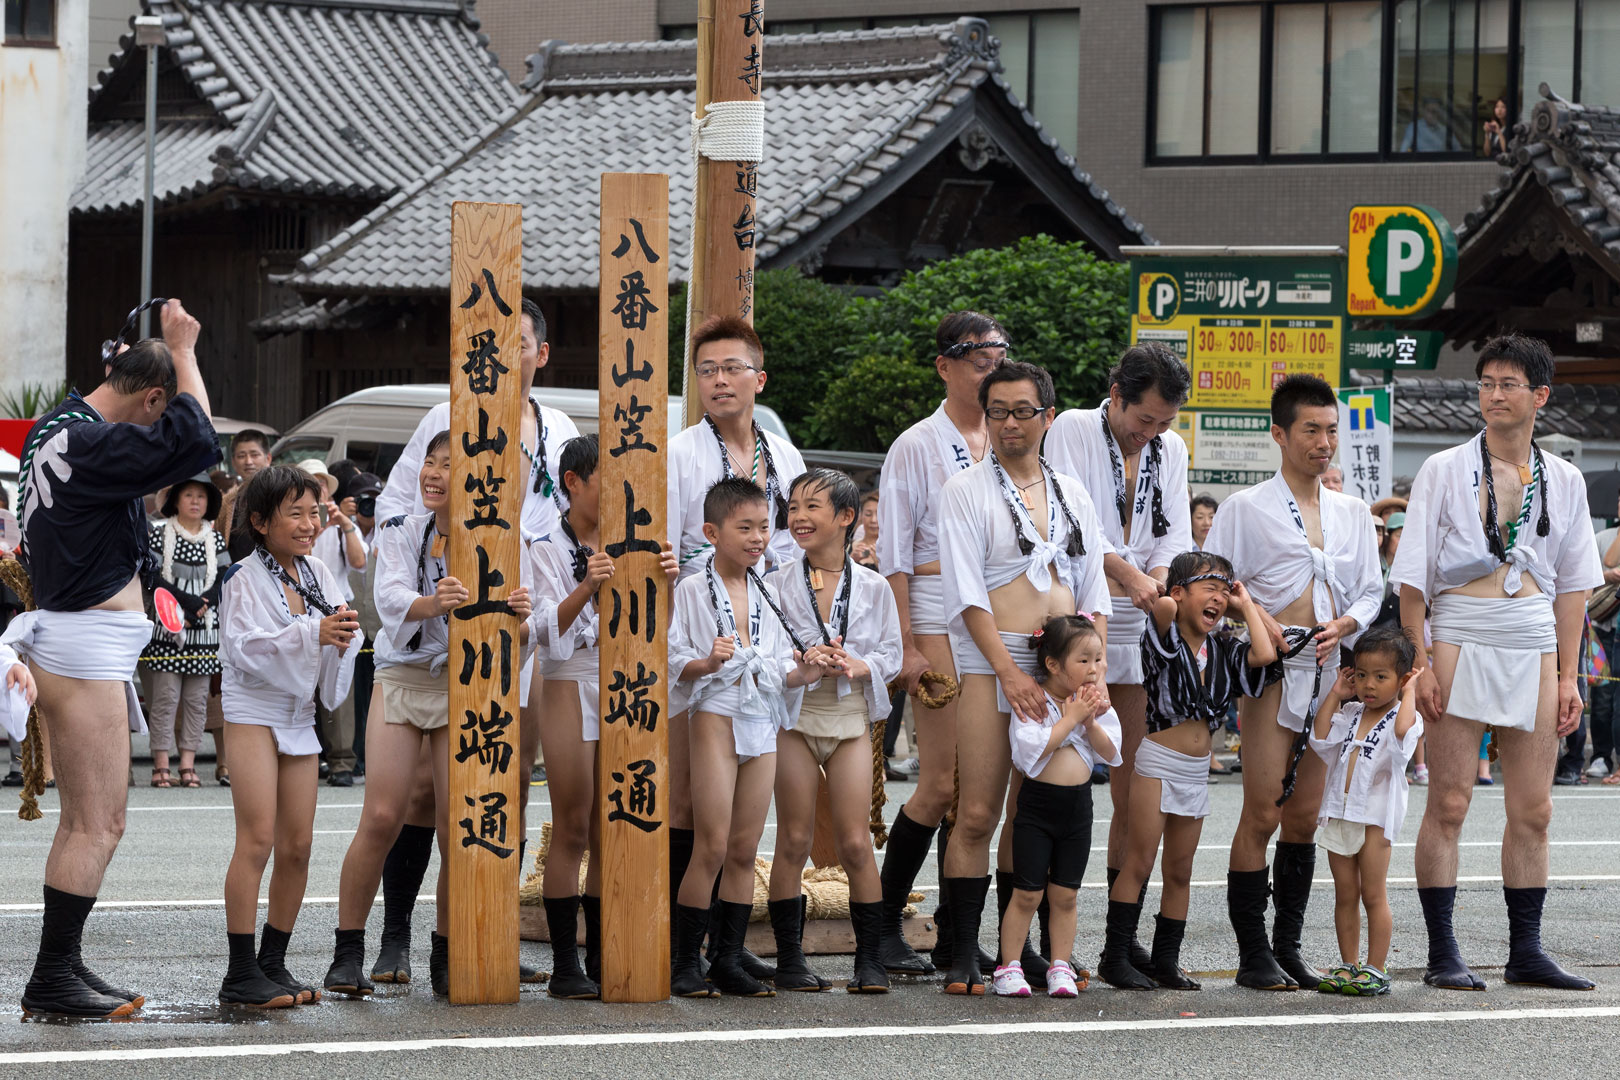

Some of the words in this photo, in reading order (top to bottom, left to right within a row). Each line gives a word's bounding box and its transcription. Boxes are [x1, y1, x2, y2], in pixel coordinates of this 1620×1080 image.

[1386, 229, 1425, 296] P
[1156, 283, 1174, 316] P
[1184, 277, 1270, 308] 三井のリパーク
[1395, 335, 1417, 364] 空
[1216, 371, 1251, 390] 500円
[952, 445, 970, 469] 上
[605, 218, 662, 833] 八番山笠上川端通
[453, 268, 517, 859] 八番山笠上川端通
